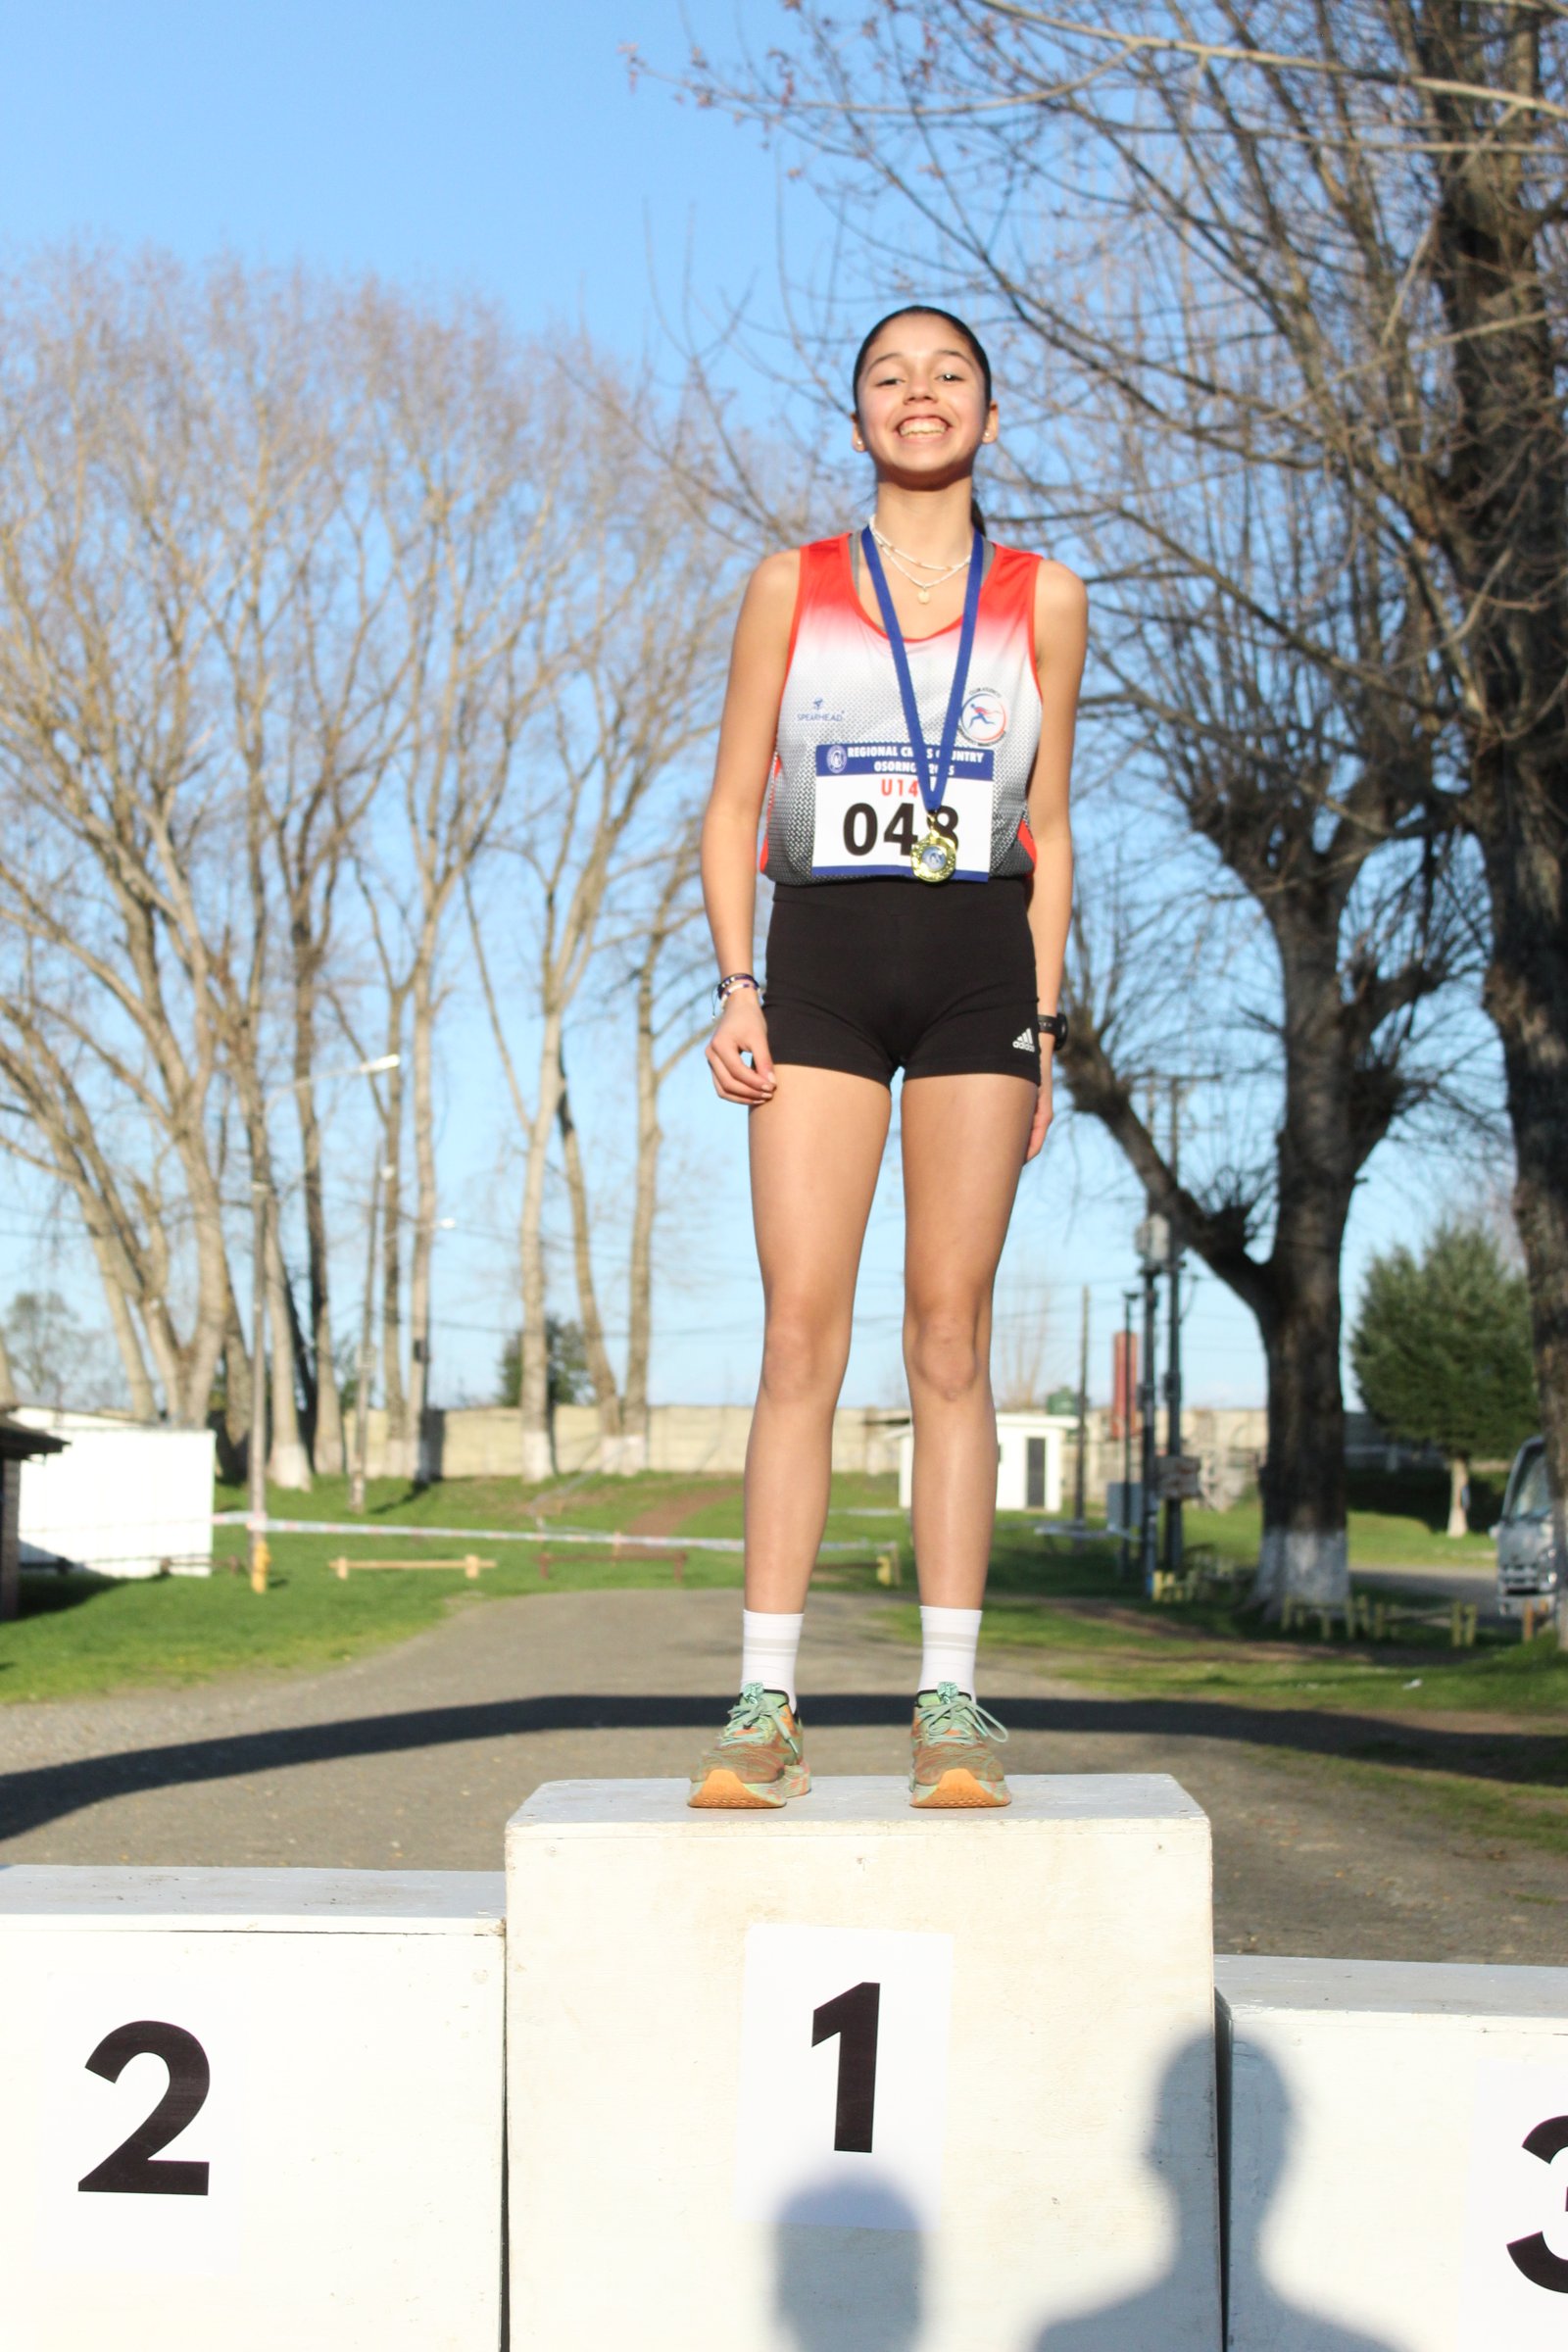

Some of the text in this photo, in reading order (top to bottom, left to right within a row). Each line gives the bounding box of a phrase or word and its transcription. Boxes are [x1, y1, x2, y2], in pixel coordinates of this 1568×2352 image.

[847, 746, 899, 759] REGIONAL
[78, 2020, 211, 2196] 2
[811, 1982, 881, 2153] 1
